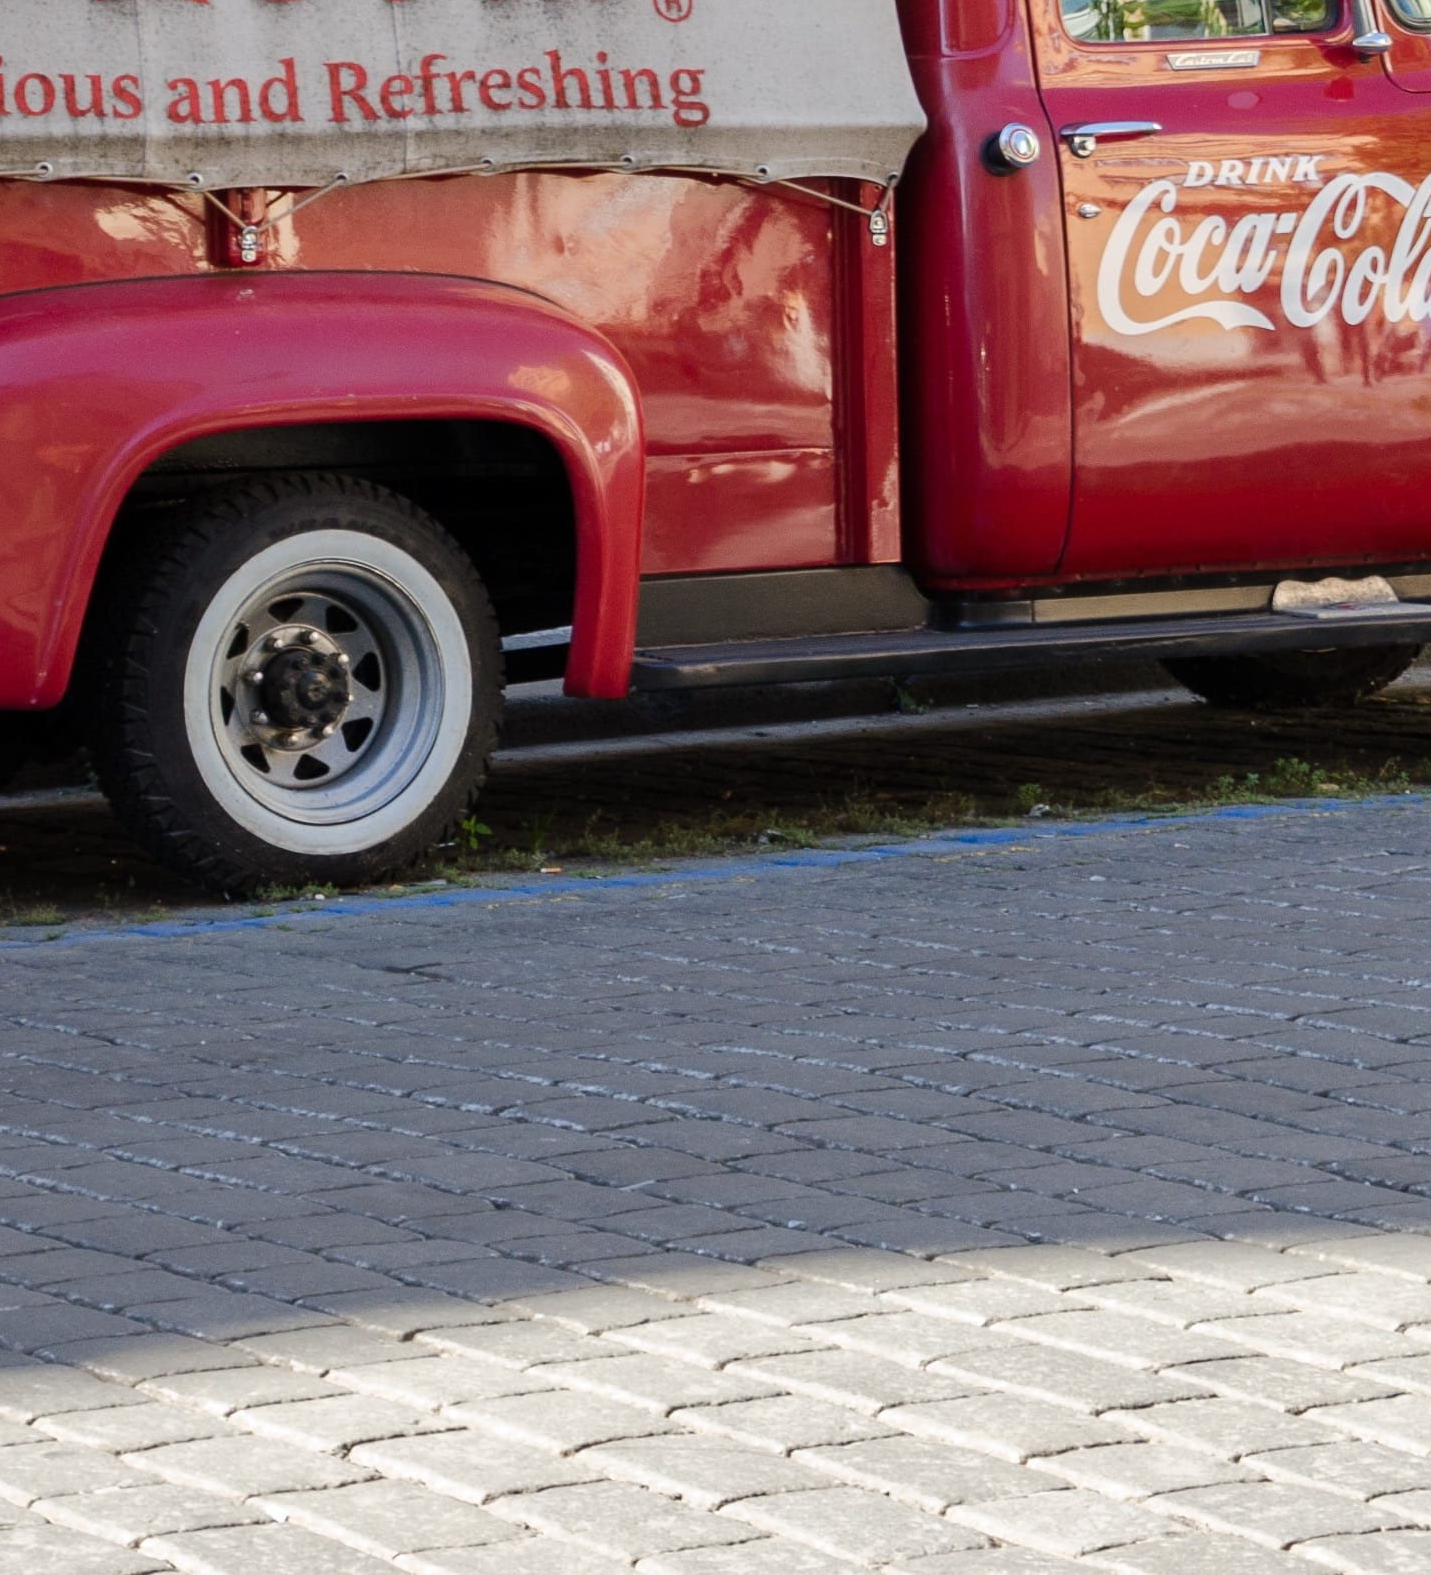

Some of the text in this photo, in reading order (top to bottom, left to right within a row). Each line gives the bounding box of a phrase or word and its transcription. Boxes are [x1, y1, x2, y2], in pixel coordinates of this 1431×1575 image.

[167, 56, 305, 125] and
[323, 49, 712, 129] Refreshing
[1182, 153, 1329, 189] DRINK
